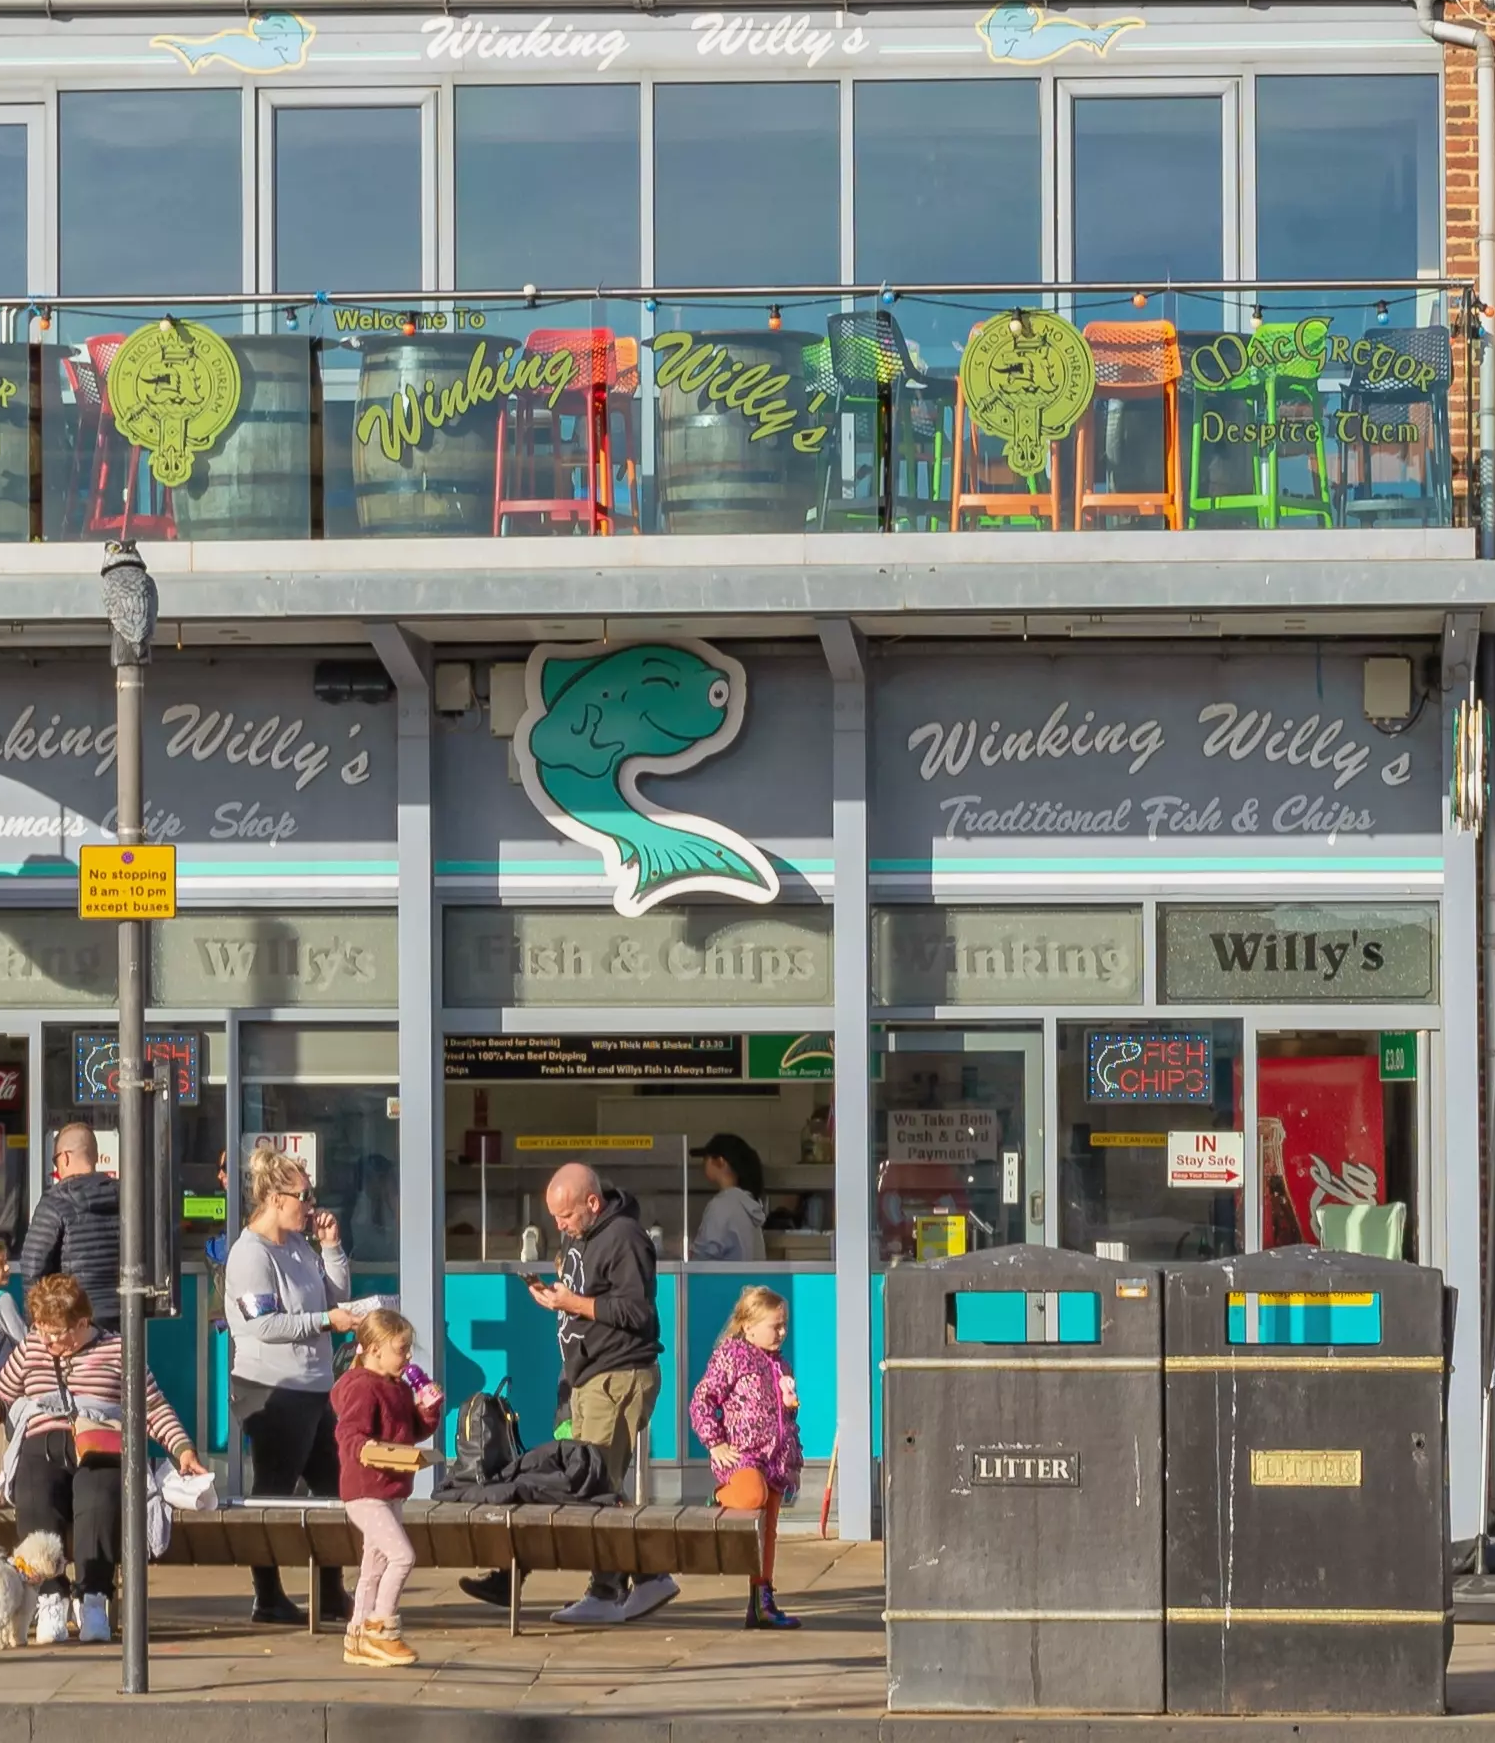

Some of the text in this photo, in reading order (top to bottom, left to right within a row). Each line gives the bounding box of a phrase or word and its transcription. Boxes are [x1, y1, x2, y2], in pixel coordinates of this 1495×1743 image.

[419, 9, 870, 71] Winking Willy's
[453, 307, 486, 330] To
[1042, 323, 1064, 343] MO
[1064, 344, 1082, 403] DHREAM
[1190, 315, 1438, 394] MacGregor
[211, 357, 229, 414] DHREAM
[356, 330, 828, 463] Winking Willy's
[1201, 408, 1421, 445] Despite Them
[162, 703, 371, 790] Willy's
[907, 701, 1412, 790] Winking Willy's
[208, 802, 299, 848] Shop
[939, 794, 1377, 845] Traditional Fish & Chips
[89, 869, 167, 882] No stopping
[89, 885, 167, 898] 8 am 10 pm
[85, 900, 170, 914] except buses
[607, 934, 652, 981] &
[659, 937, 817, 990] Chips
[1208, 930, 1385, 981] Willy's
[488, 1038, 513, 1048] Board
[515, 1038, 527, 1048] for
[591, 1040, 618, 1051] Willy's
[619, 1040, 641, 1050] Thick
[642, 1040, 661, 1050] Milk
[662, 1040, 693, 1050] Shakes
[1142, 1041, 1205, 1067] FISH
[478, 1051, 504, 1062] 100%
[505, 1051, 525, 1061] Pure
[527, 1051, 547, 1061] Beef
[548, 1051, 587, 1063] Dripping
[445, 1064, 469, 1076] Chips
[541, 1065, 565, 1075] Fresh
[576, 1065, 596, 1075] Best
[597, 1065, 614, 1075] and
[644, 1065, 663, 1075] Fish
[664, 1065, 672, 1075] is
[673, 1065, 705, 1077] Always
[798, 1068, 822, 1078] Away
[1119, 1068, 1205, 1093] CHIPS
[921, 1113, 954, 1127] Take
[897, 1129, 933, 1143] Cash
[938, 1130, 949, 1143] &
[1195, 1134, 1217, 1153] IN
[1176, 1154, 1236, 1168] Stay Safe
[978, 1457, 1070, 1479] LITTER
